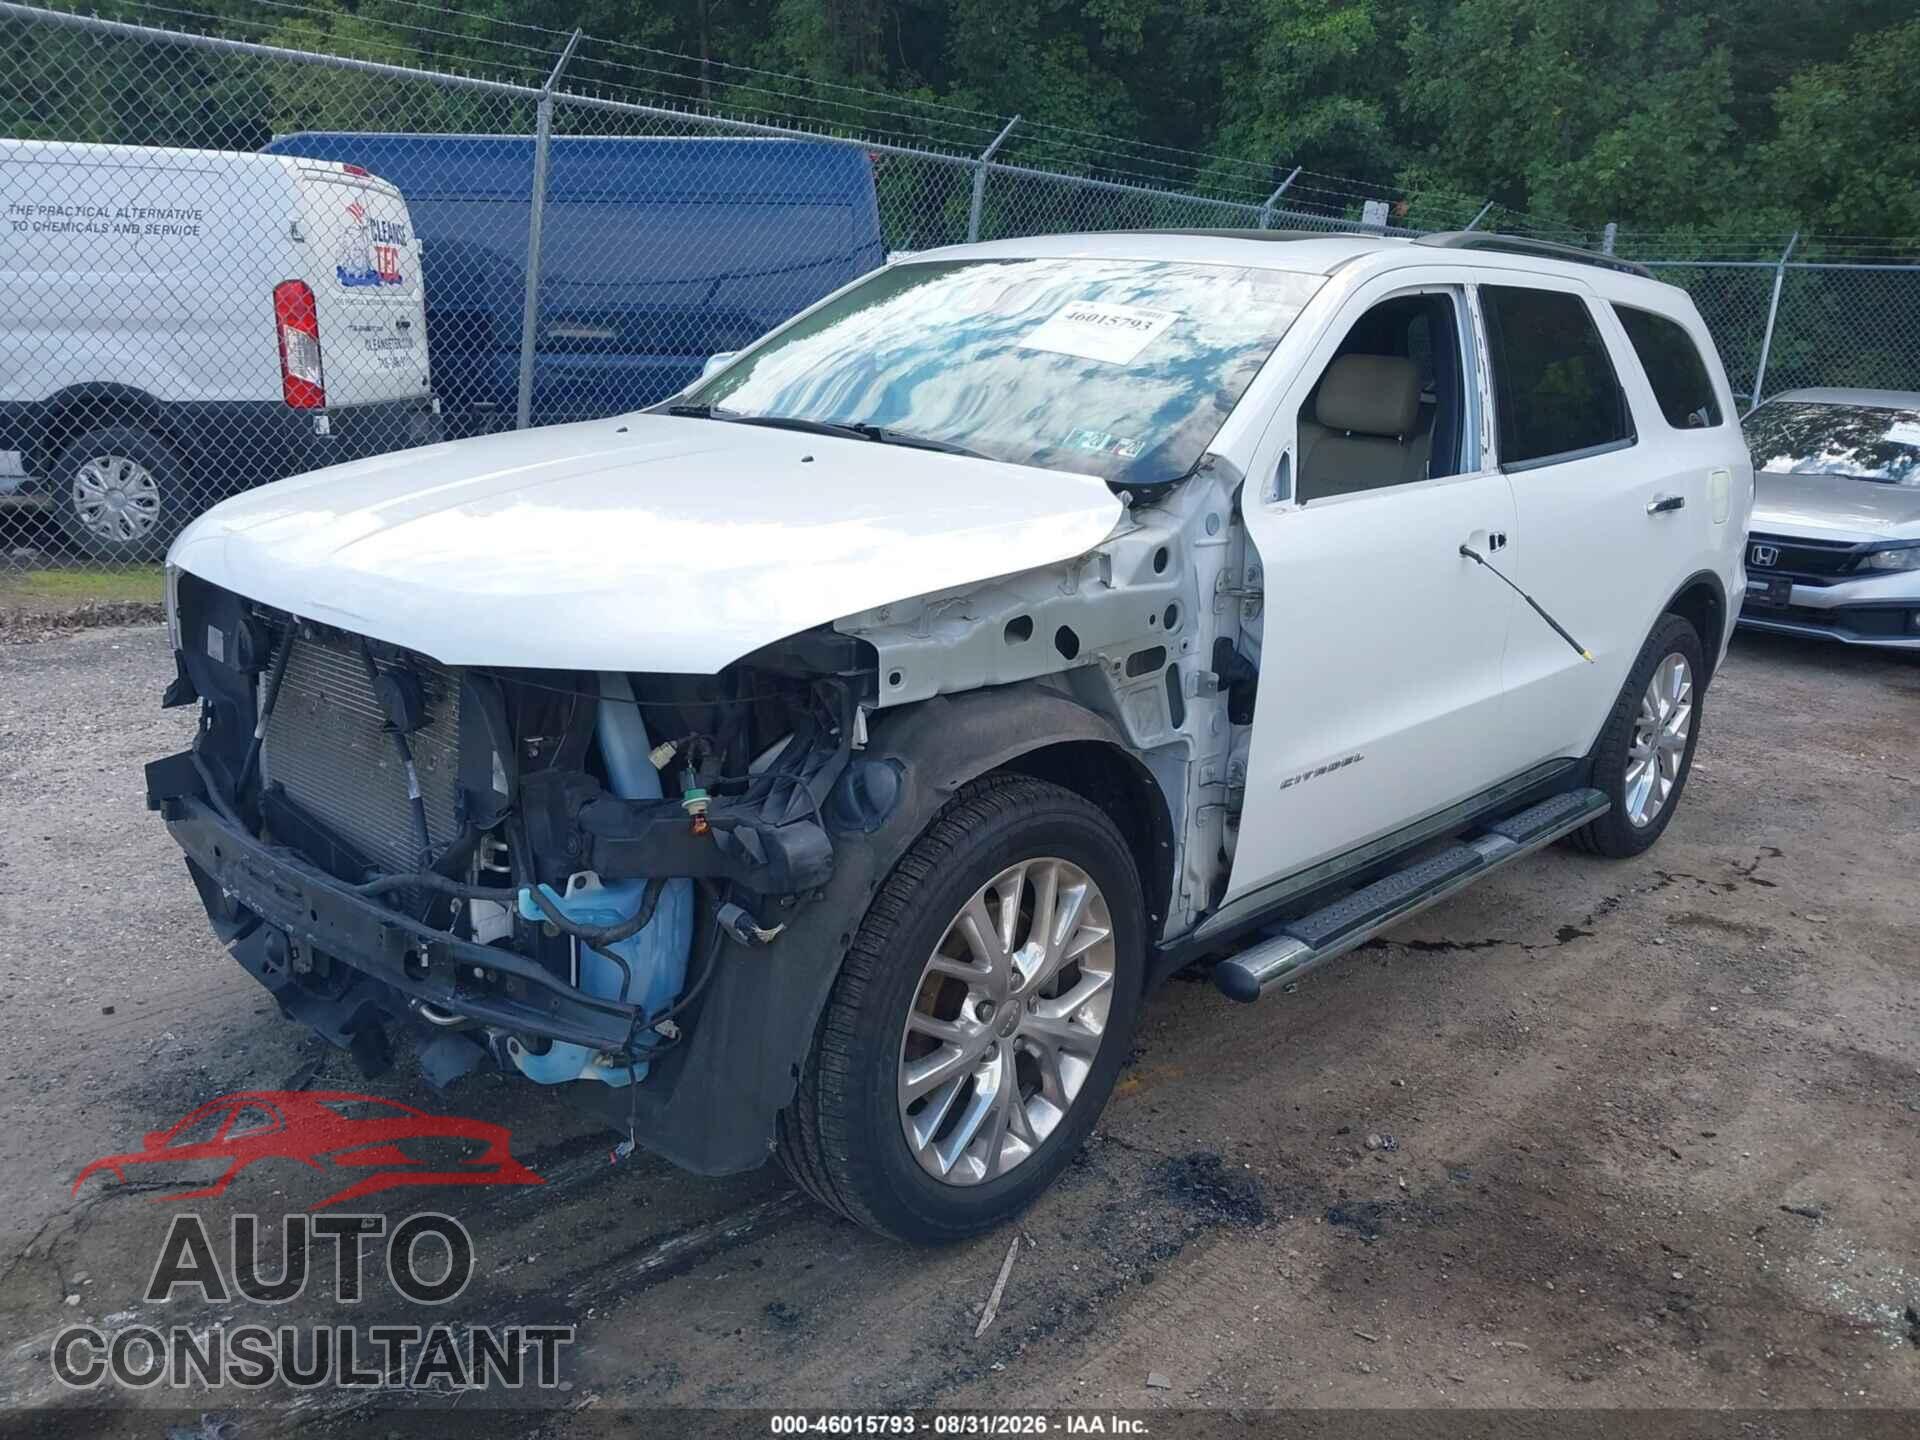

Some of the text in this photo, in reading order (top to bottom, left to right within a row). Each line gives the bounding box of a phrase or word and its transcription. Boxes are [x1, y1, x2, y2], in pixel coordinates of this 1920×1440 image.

[9, 204, 203, 220] THE PRACTICAL ALTERNATIVE
[12, 221, 200, 236] TO CHEMICALS AND SERVICE
[1065, 311, 1153, 331] 46015793
